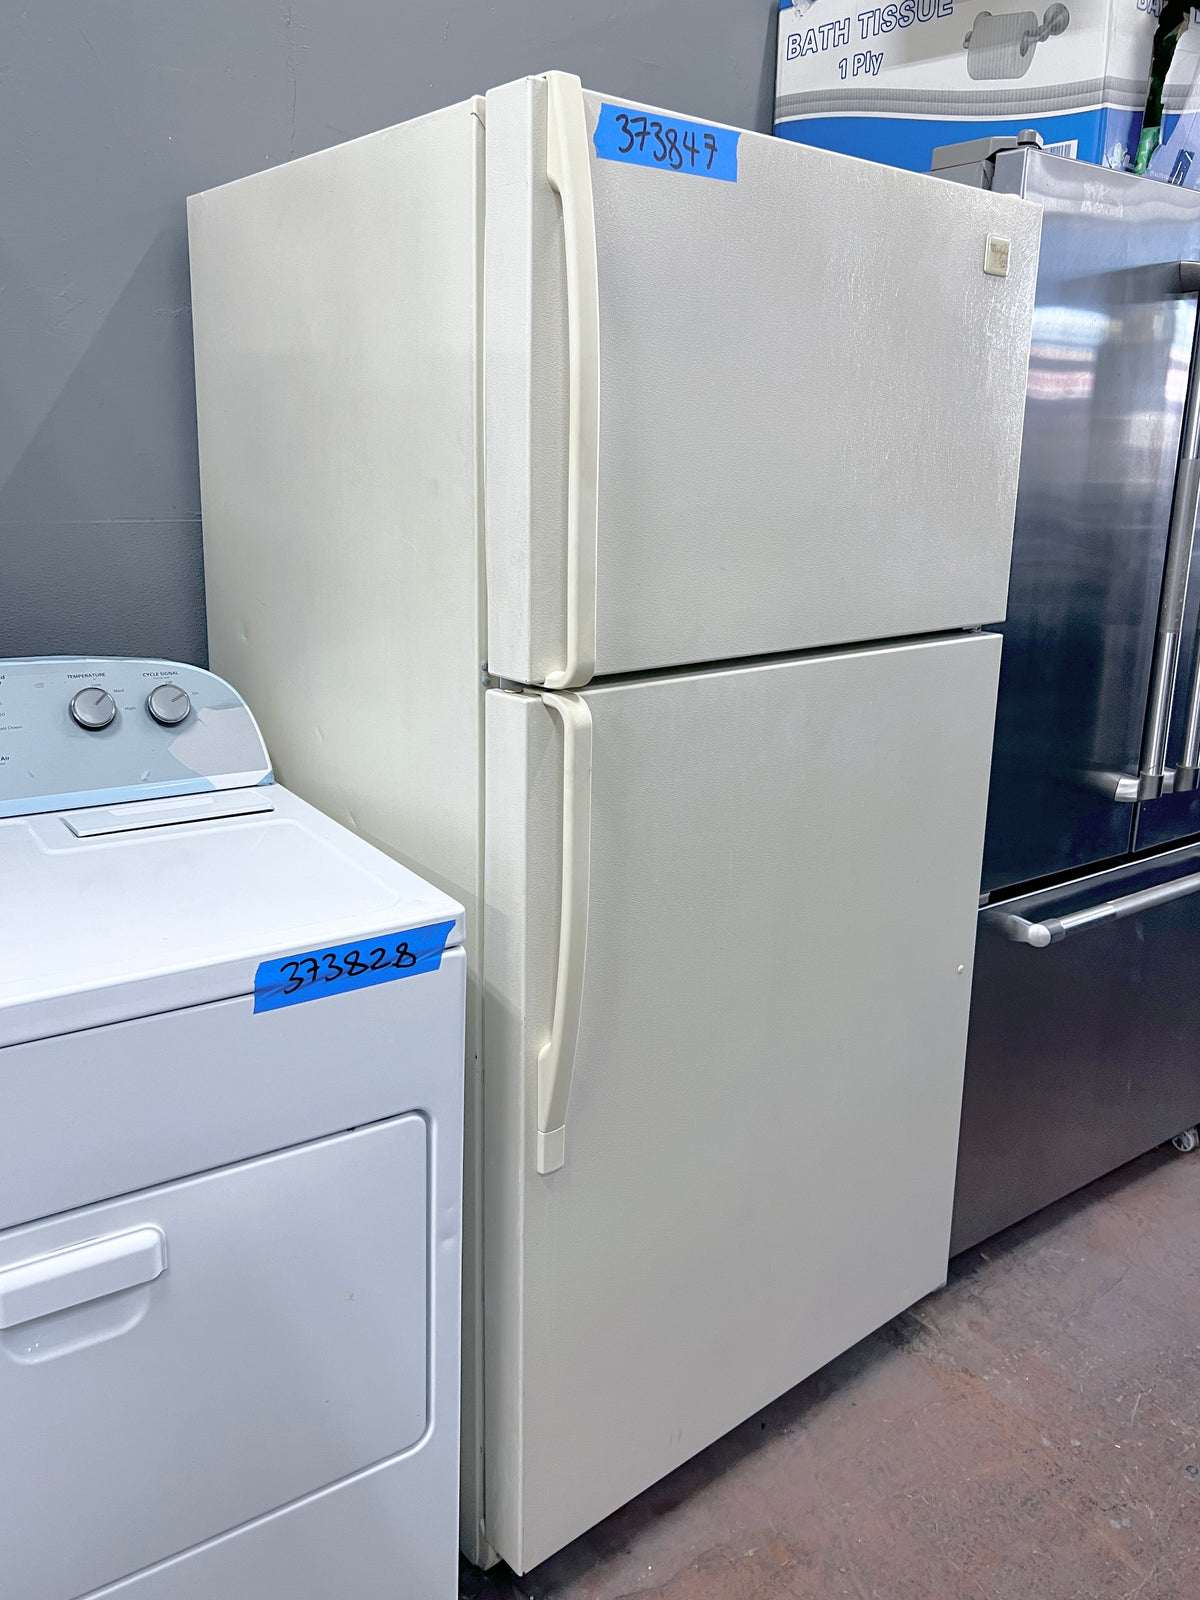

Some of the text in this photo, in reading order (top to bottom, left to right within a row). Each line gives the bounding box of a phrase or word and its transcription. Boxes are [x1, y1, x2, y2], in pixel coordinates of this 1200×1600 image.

[786, 0, 954, 61] BATH TISSUE
[838, 50, 884, 80] 1 Ply
[615, 113, 718, 170] 373847
[280, 942, 417, 994] 373828
